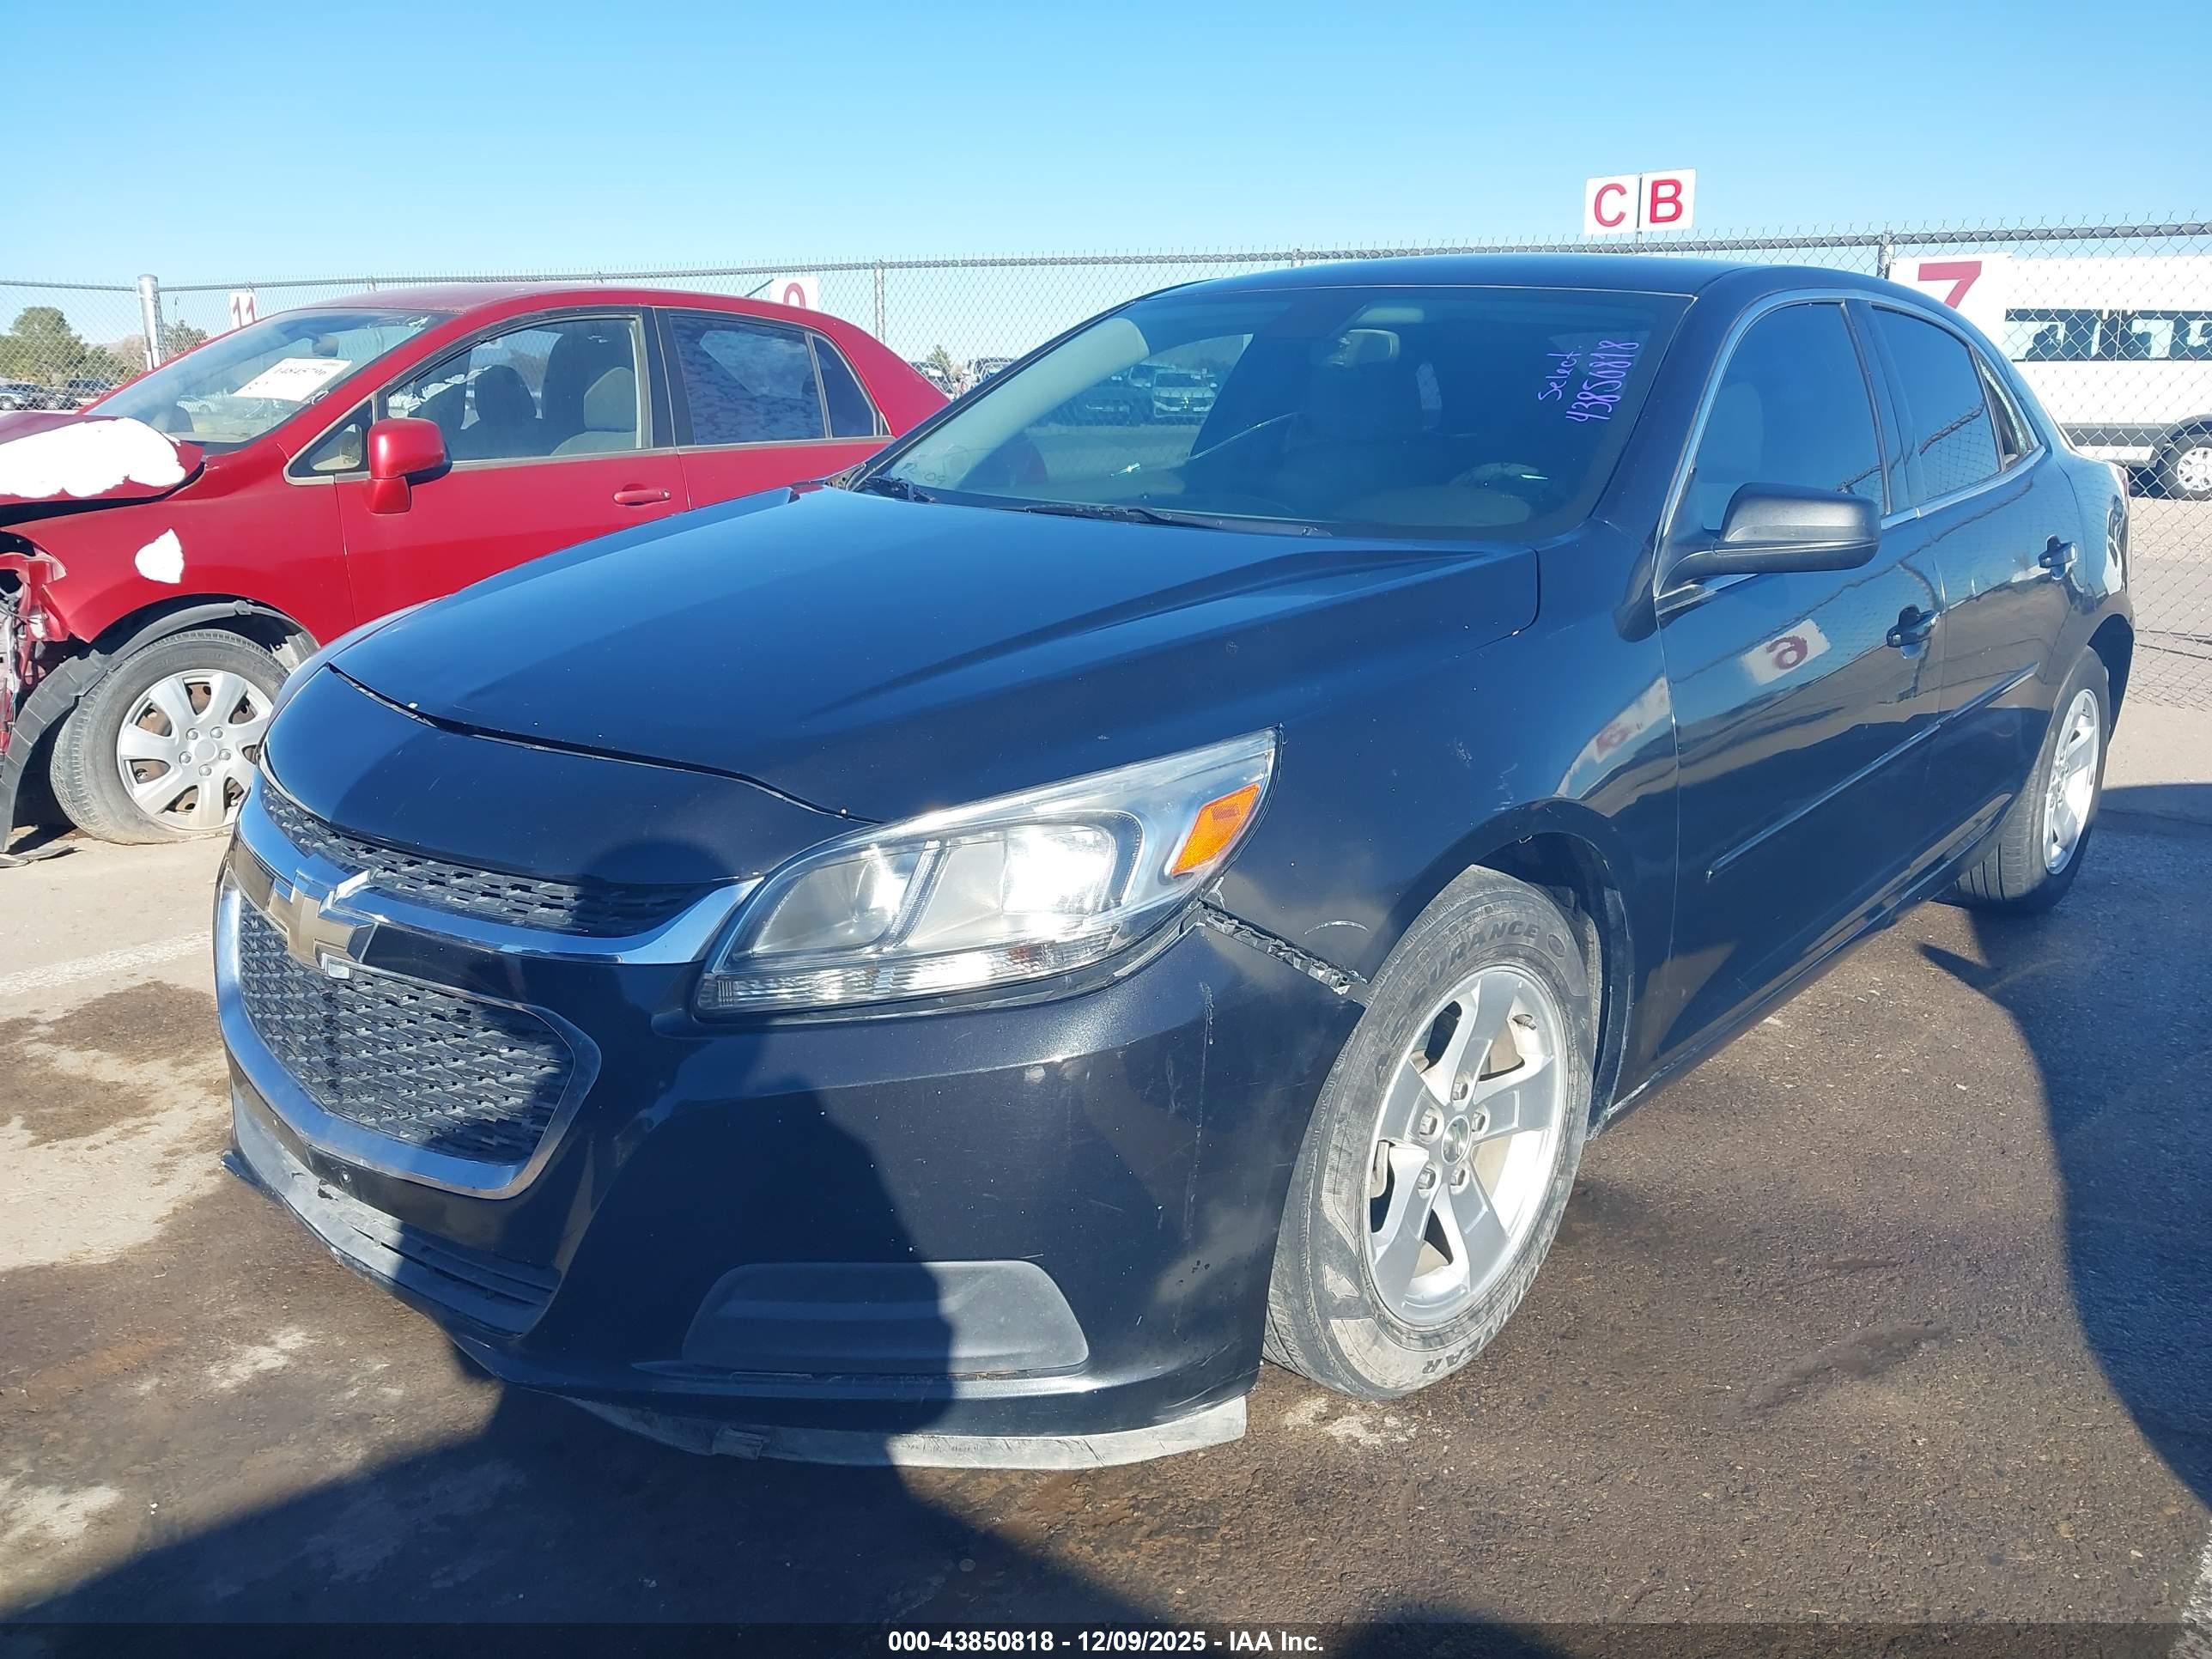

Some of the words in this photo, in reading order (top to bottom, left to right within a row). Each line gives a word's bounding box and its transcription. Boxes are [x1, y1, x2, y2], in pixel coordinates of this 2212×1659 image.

[1594, 183, 1627, 228] C
[1649, 178, 1683, 224] B
[1565, 340, 1640, 422] 43850818
